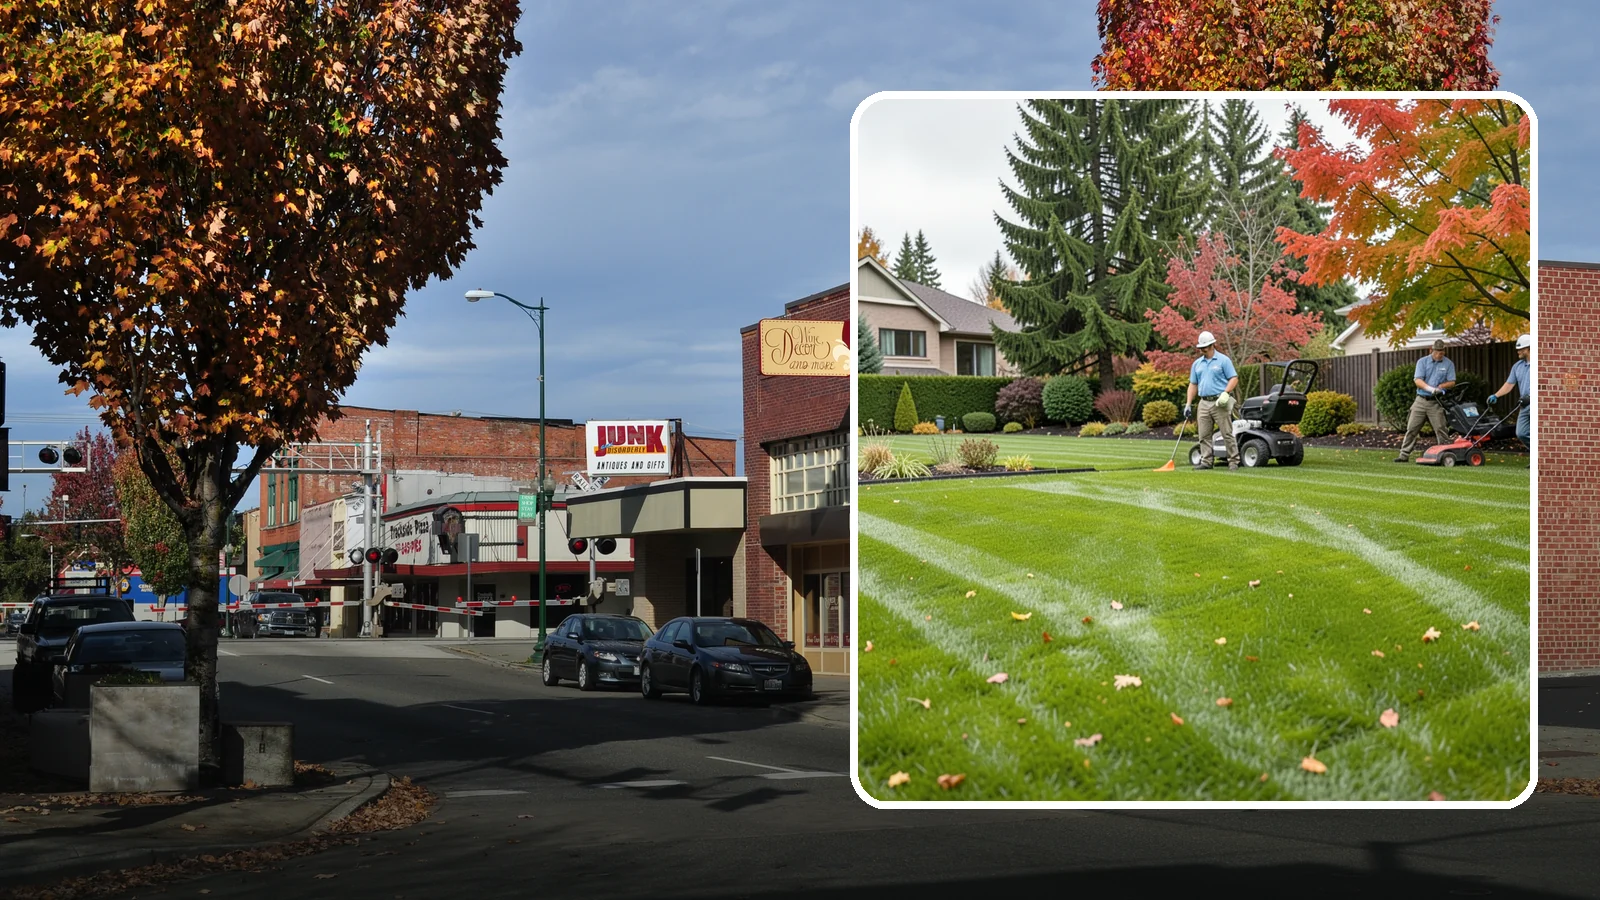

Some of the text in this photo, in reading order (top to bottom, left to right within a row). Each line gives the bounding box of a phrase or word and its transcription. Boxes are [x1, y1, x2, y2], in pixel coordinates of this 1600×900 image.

[595, 425, 664, 457] JUNK
[607, 446, 646, 454] DISORDERLY
[596, 460, 665, 470] ANTIQUES AND GIFTS
[414, 519, 429, 534] Pizza
